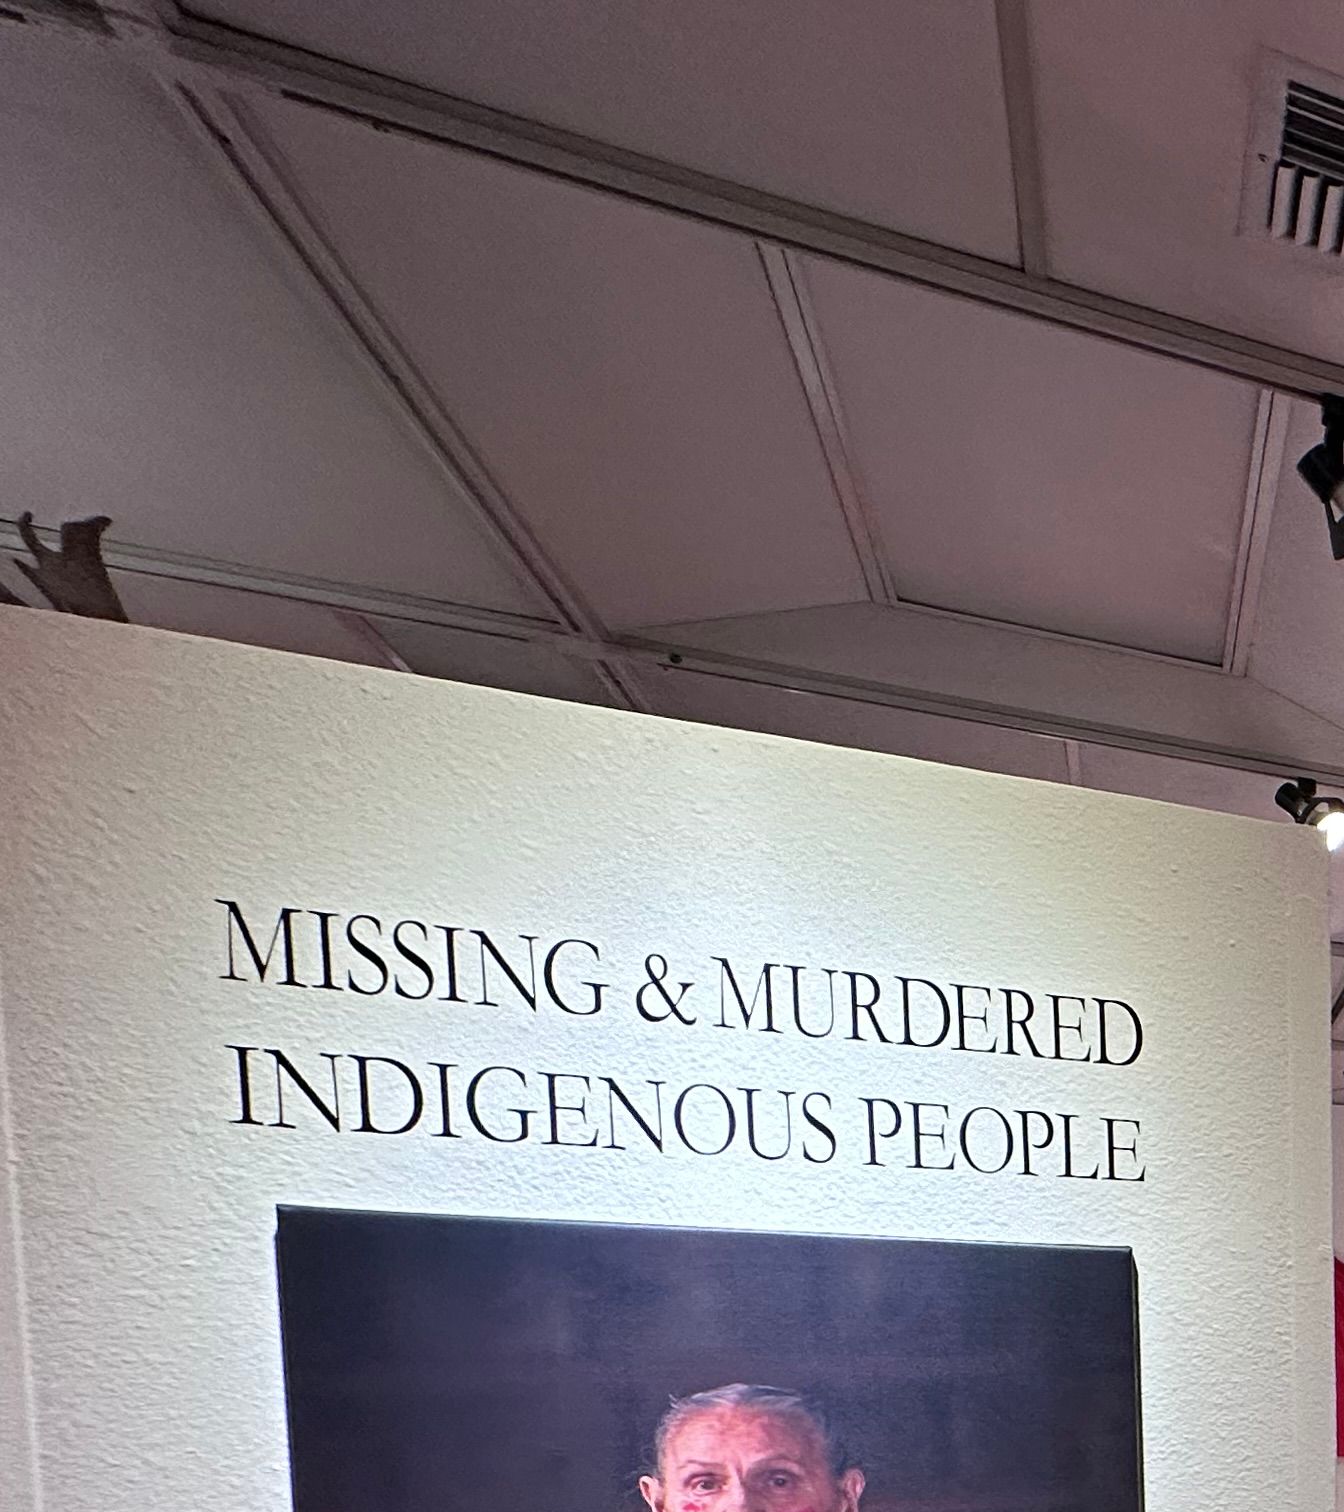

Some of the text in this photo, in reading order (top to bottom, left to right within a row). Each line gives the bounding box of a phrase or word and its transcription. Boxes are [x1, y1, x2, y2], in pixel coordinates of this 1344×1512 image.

[213, 898, 1144, 1068] MISSING & MURDERED
[223, 1044, 1147, 1183] INDIGENOUS PEOPLE
